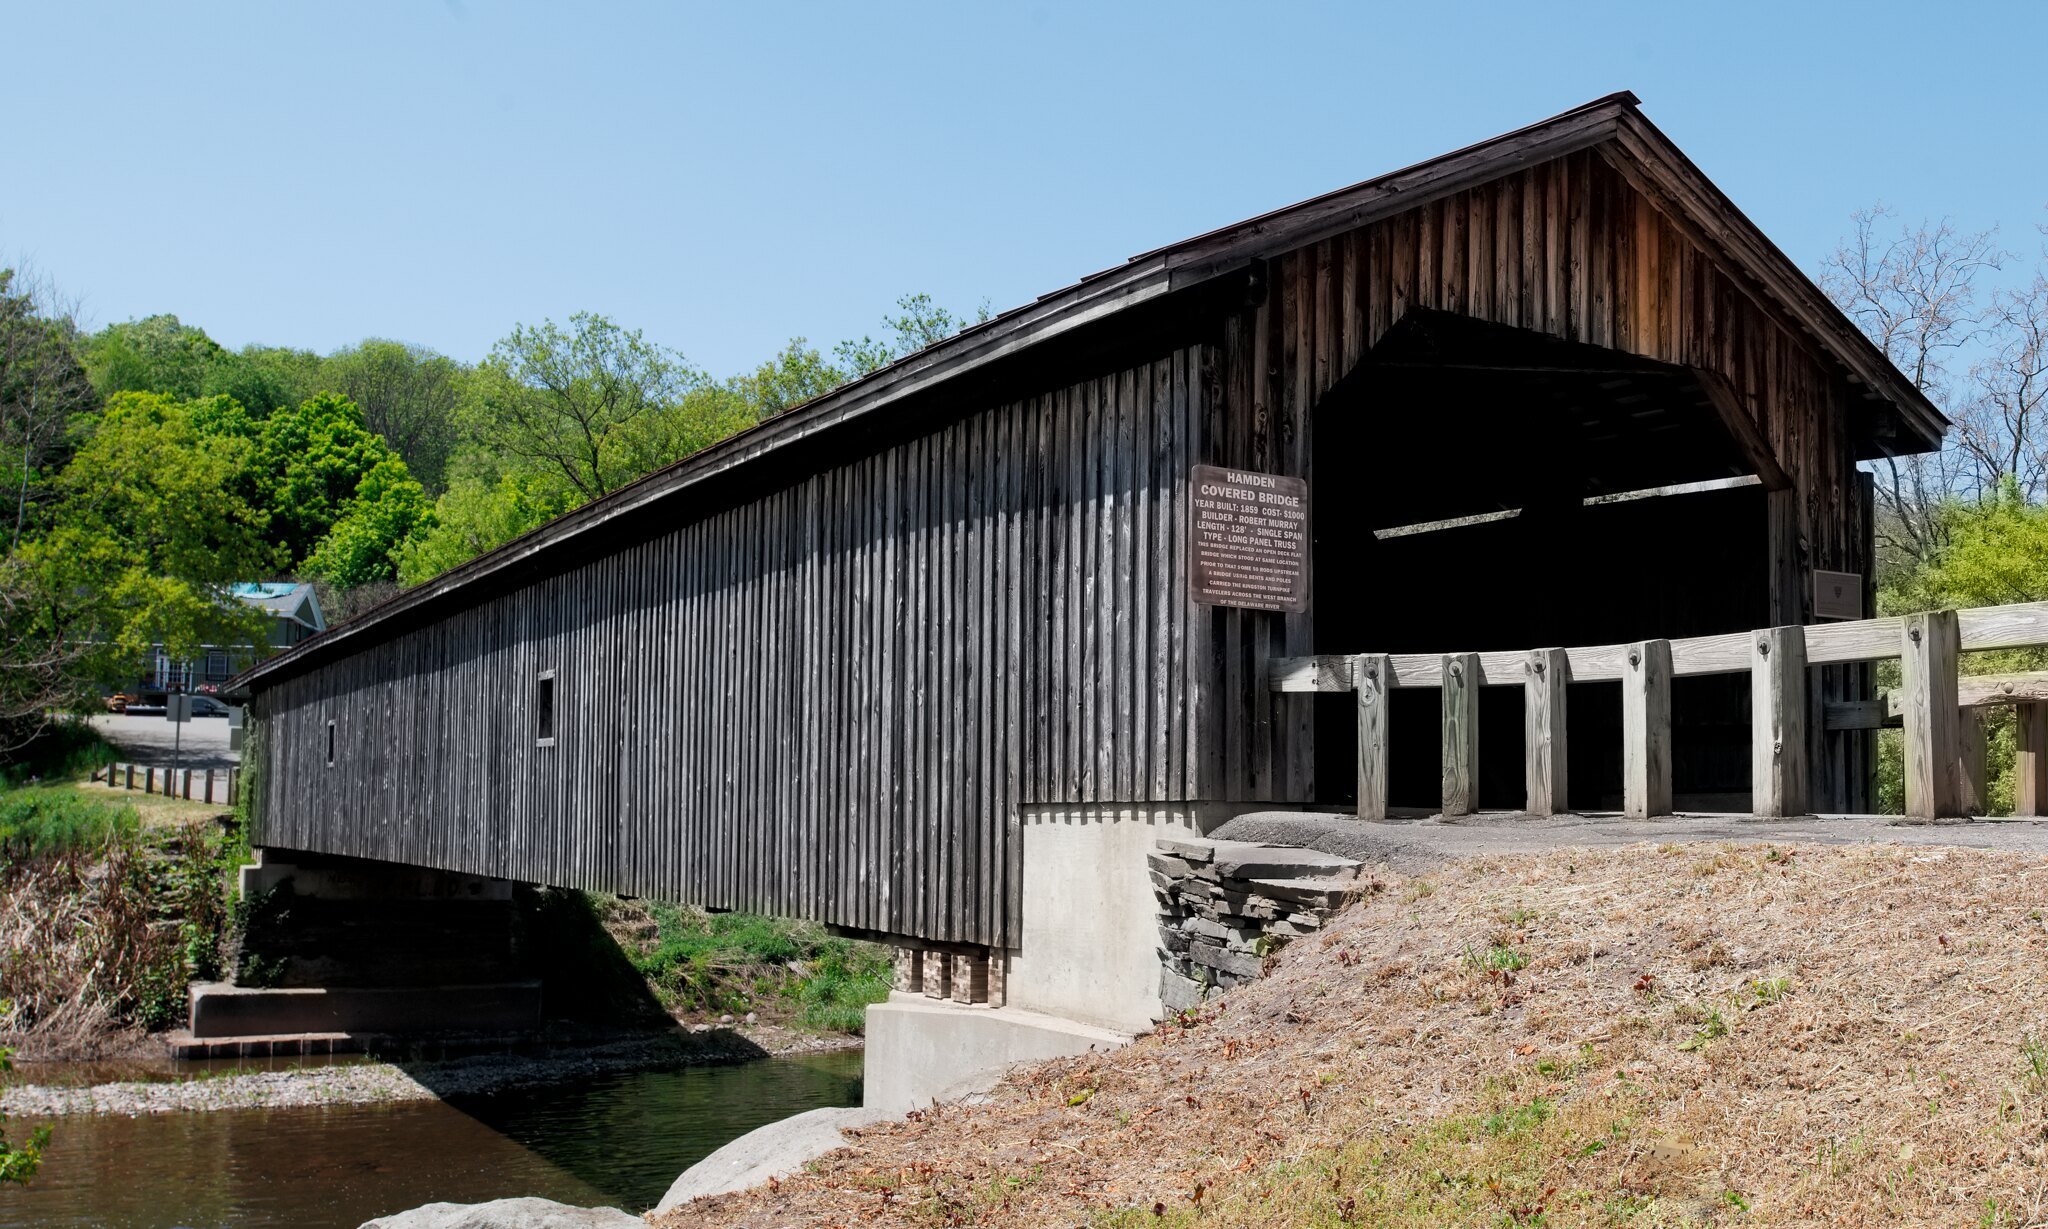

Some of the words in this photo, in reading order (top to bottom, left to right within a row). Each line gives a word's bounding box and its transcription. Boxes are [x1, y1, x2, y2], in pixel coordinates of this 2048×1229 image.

[1228, 472, 1275, 488] HAMDEN
[1201, 485, 1255, 500] COVERED
[1259, 492, 1299, 507] BRIDGE
[1195, 499, 1214, 508] YEAR
[1217, 502, 1238, 511] BUILT:
[1241, 505, 1258, 514] 1859
[1284, 511, 1304, 520] $1000
[1202, 511, 1233, 521] BUILDER
[1239, 516, 1266, 526] ROBERT
[1269, 519, 1298, 529] MURRAY
[1197, 521, 1225, 531] LENGTH
[1232, 525, 1246, 533] 128'
[1257, 528, 1282, 538] SINGLE
[1284, 532, 1302, 540] SPAN
[1204, 532, 1222, 541] TYPE
[1229, 535, 1247, 544] LONG
[1250, 538, 1272, 547] PANEL
[1274, 540, 1296, 549] TRUSS
